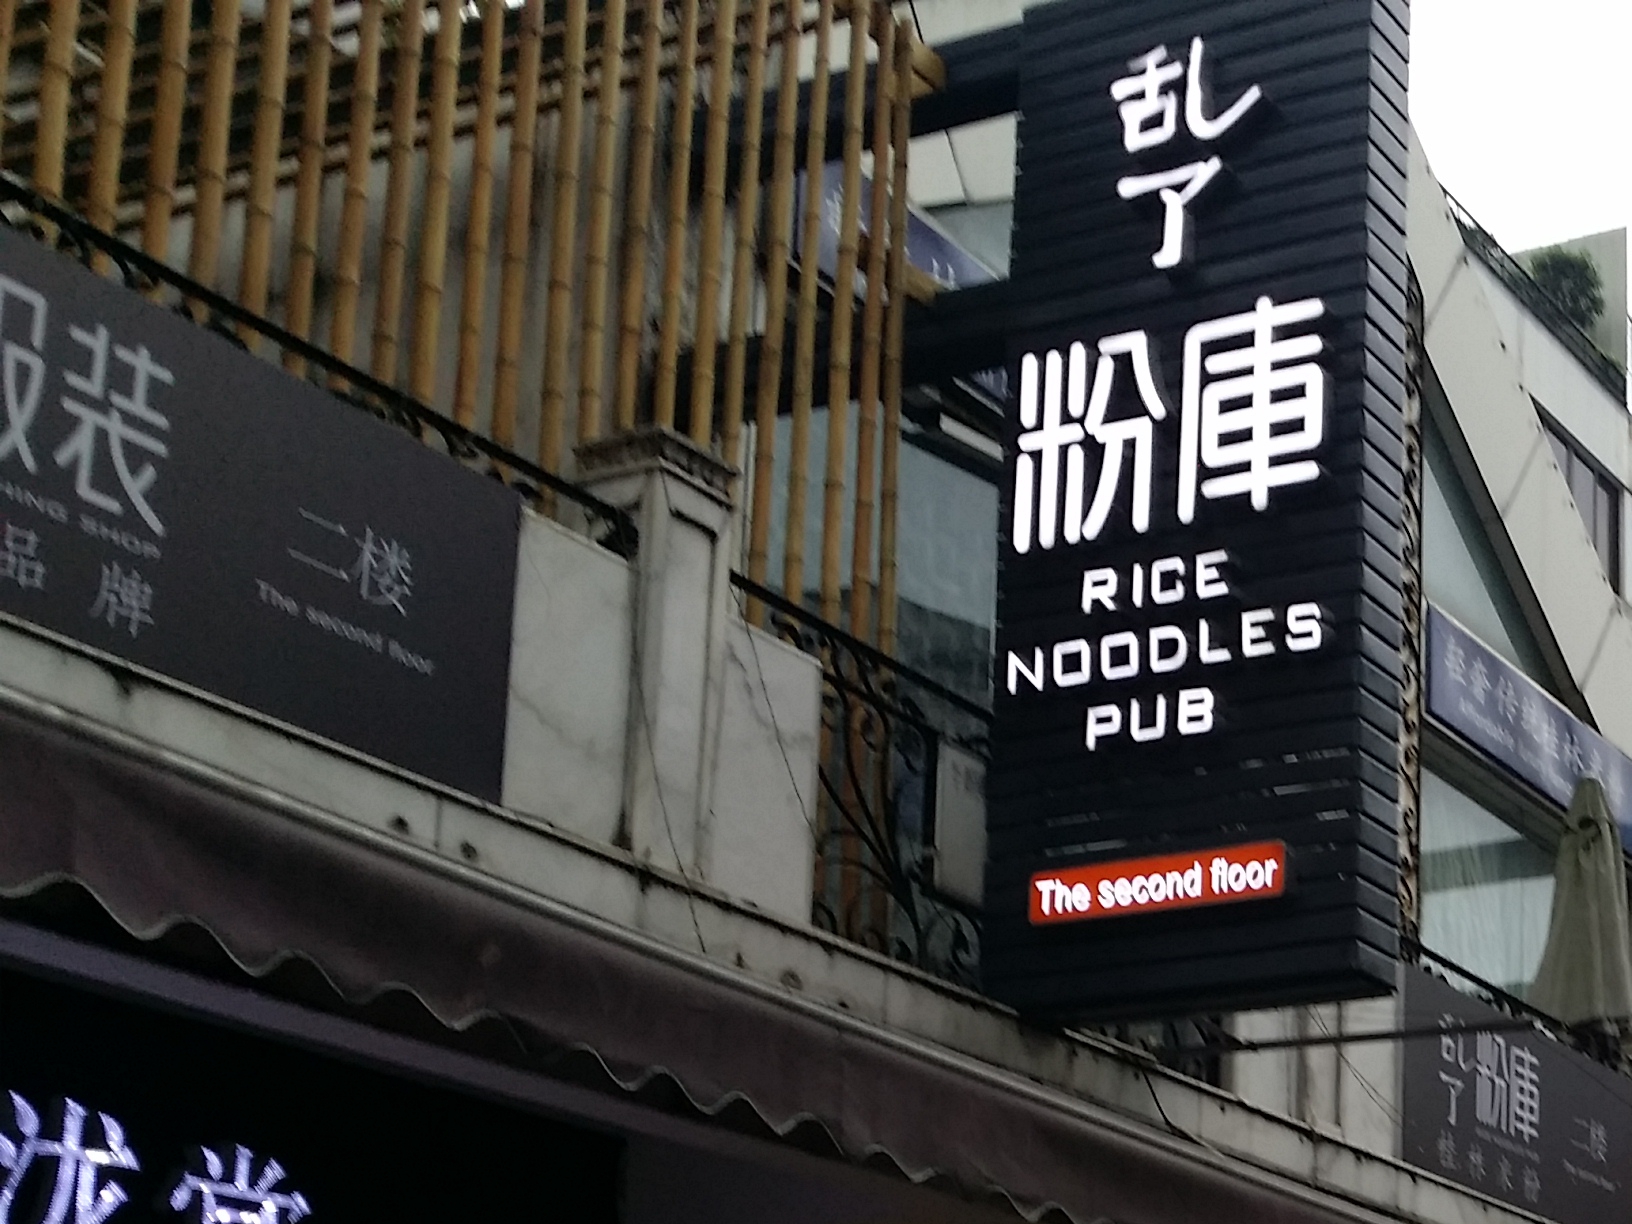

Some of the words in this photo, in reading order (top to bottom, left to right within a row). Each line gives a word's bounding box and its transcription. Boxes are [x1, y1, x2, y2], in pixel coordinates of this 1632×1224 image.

[1110, 36, 1264, 269] 乱了
[286, 506, 414, 618] 二楼
[1080, 548, 1230, 614] RICE
[1006, 601, 1323, 695] NOODLES
[1085, 686, 1216, 751] PUB
[1035, 879, 1091, 916] The
[1097, 861, 1202, 906] second
[1209, 856, 1279, 895] floor
